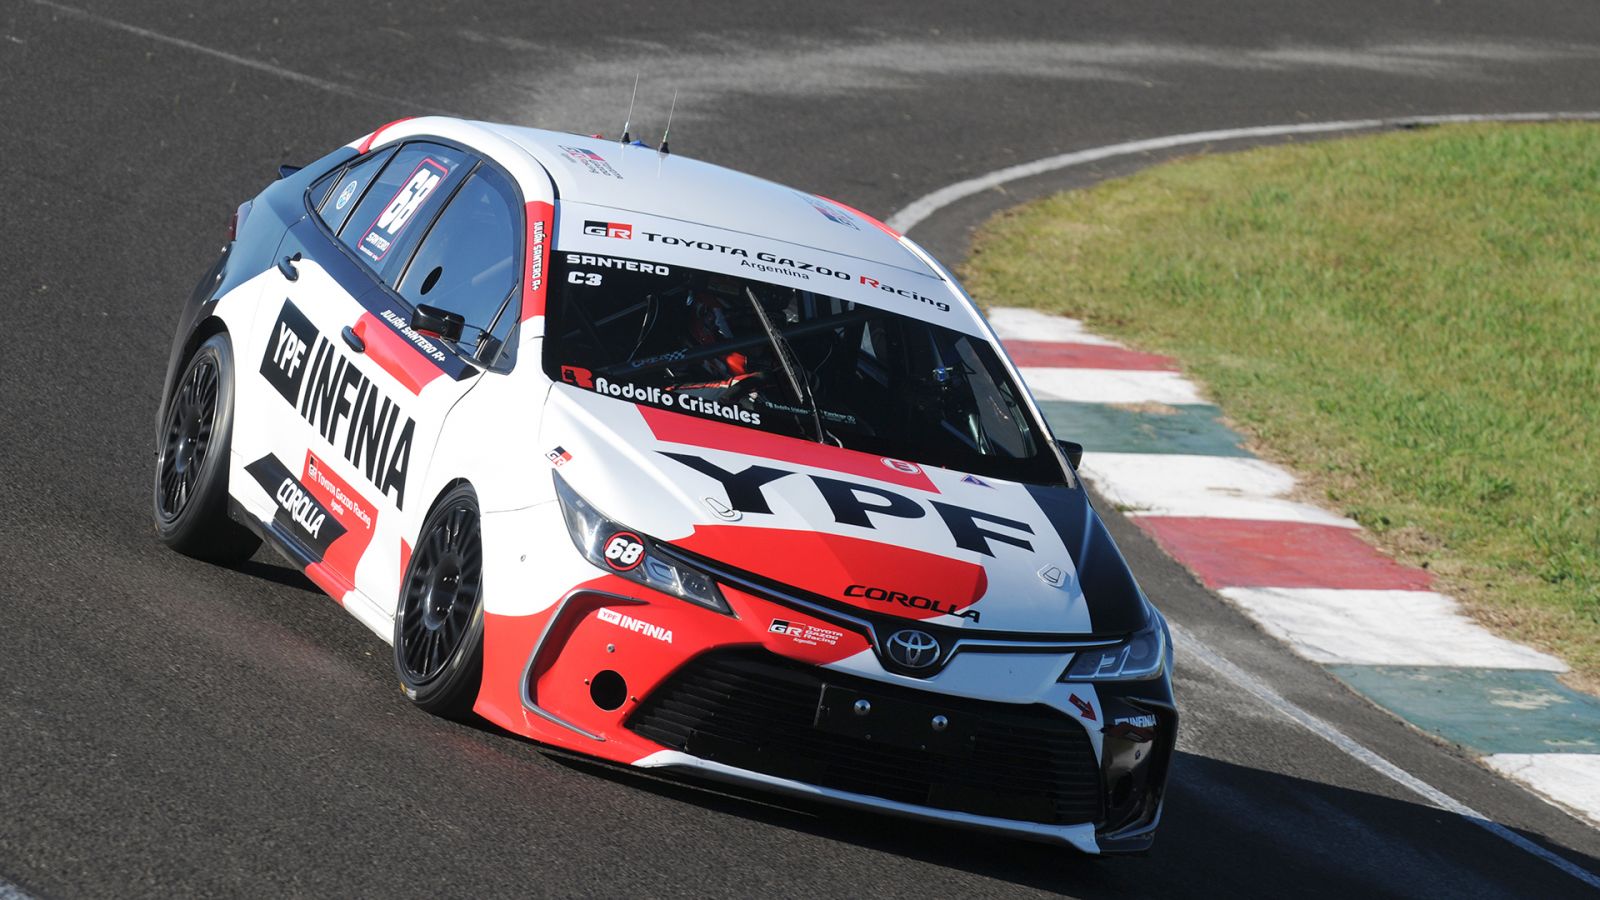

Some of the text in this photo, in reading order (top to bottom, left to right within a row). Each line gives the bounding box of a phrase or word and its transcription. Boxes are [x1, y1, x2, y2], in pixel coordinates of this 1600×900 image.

[377, 168, 440, 235] 68
[532, 245, 543, 279] SANTERO
[566, 254, 669, 276] SANTERO
[567, 271, 602, 286] C3
[584, 226, 950, 312] GR TOYOTA GAZOO Racing
[741, 259, 810, 280] Argentina
[380, 309, 407, 329] JULIÁN
[401, 326, 437, 354] SANTERO
[272, 321, 416, 512] YPF INFINIA
[596, 377, 673, 406] Rodolfo
[678, 393, 761, 425] Cristales
[276, 477, 326, 539] COROLLA
[653, 449, 1035, 558] YPF
[604, 537, 643, 564] 68
[843, 584, 981, 623] COROLLA
[602, 611, 673, 644] YPF INFINIA
[770, 624, 843, 638] GR TOYOTA
